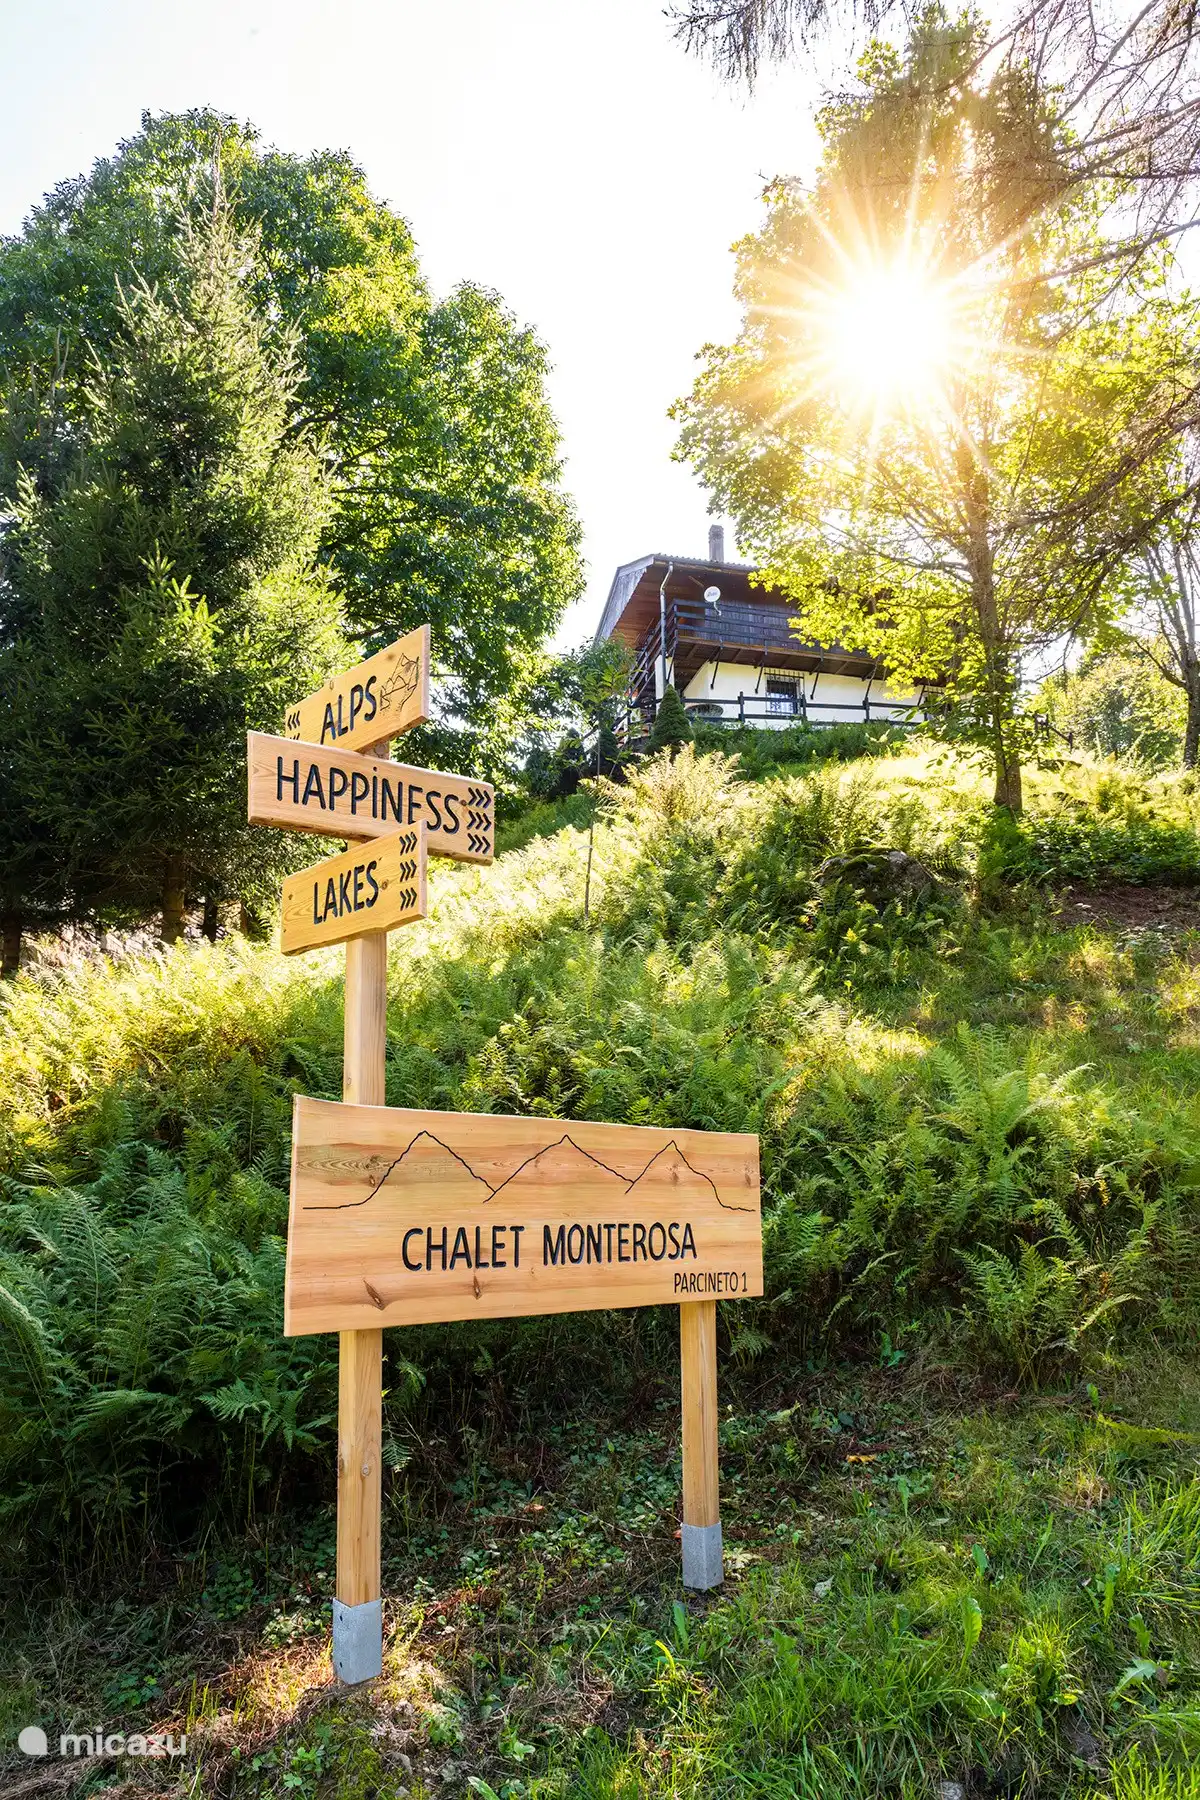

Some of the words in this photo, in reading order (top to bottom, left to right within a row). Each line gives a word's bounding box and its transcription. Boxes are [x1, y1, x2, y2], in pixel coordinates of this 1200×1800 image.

[321, 676, 376, 745] ALPS
[313, 860, 378, 924] LAKES
[402, 1225, 524, 1271] CHALET
[543, 1222, 697, 1266] MONTEROSA
[674, 1272, 738, 1293] PARCINETO
[742, 1272, 748, 1292] 1
